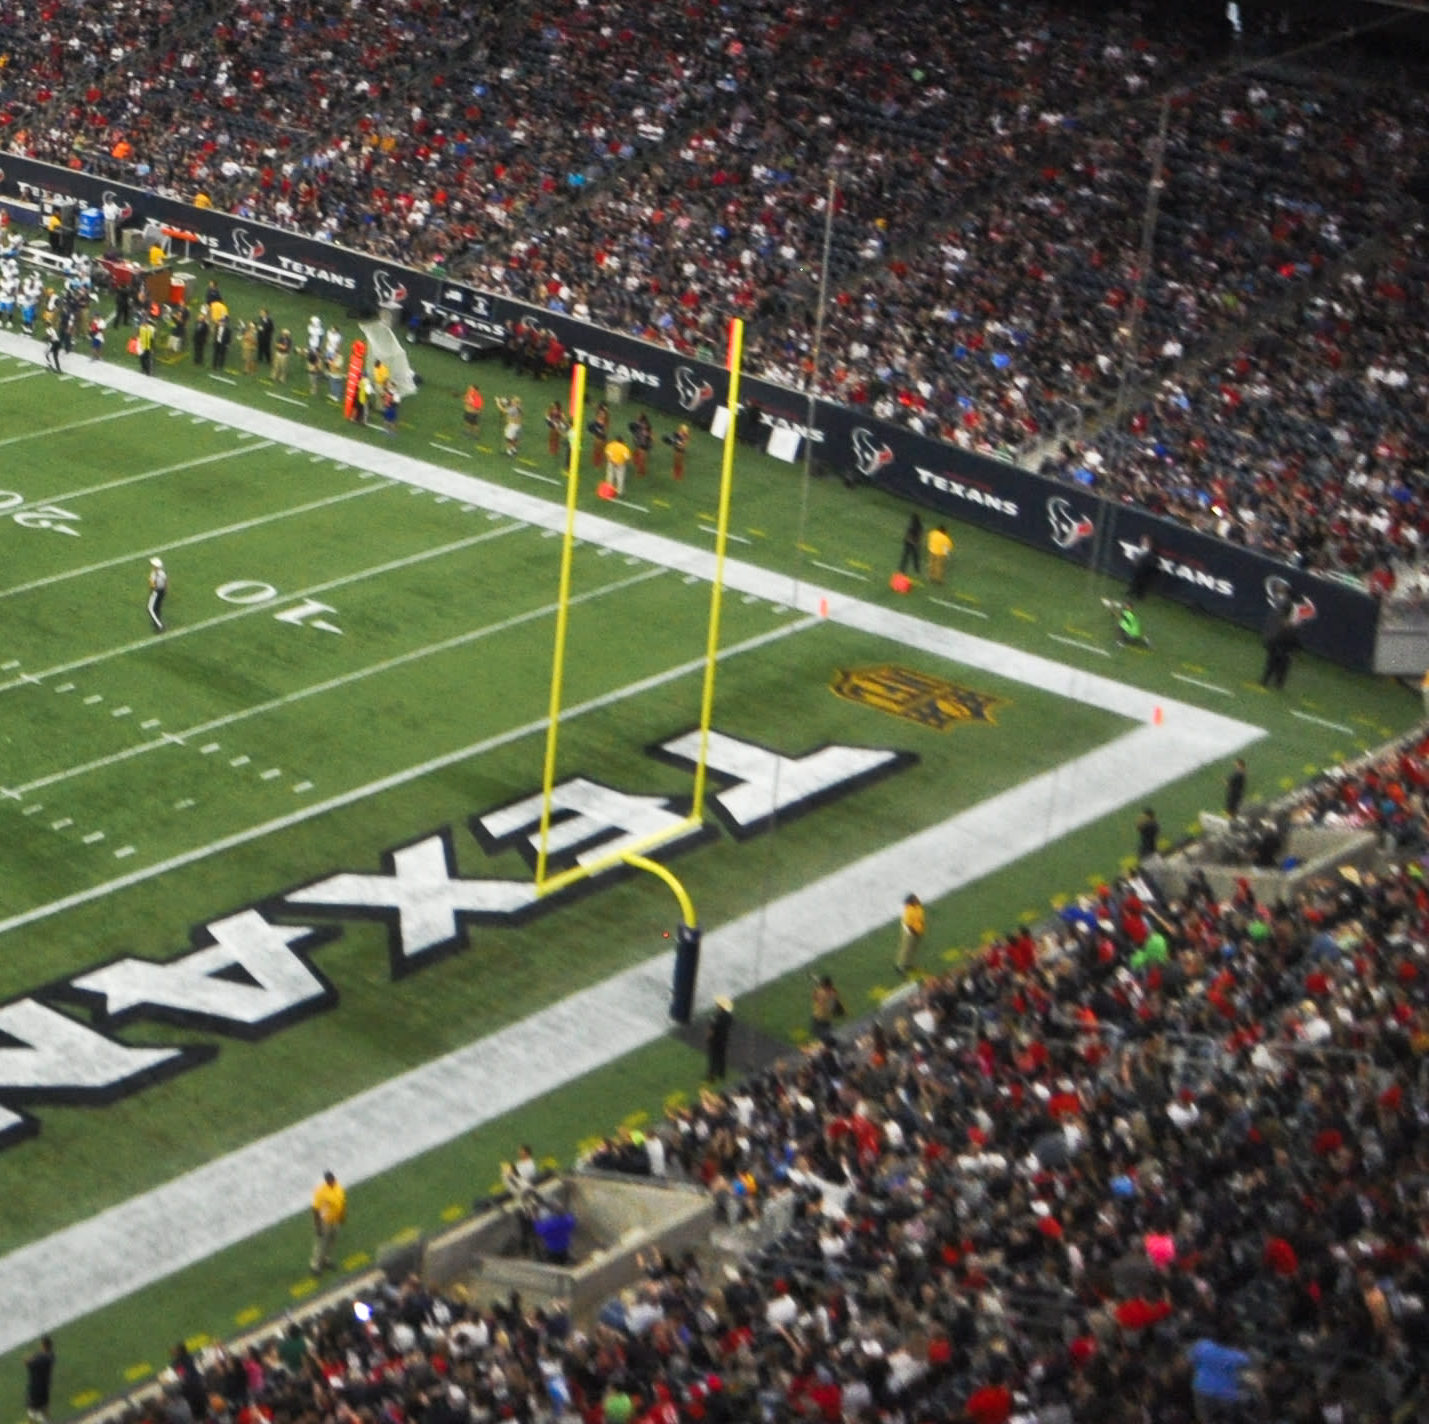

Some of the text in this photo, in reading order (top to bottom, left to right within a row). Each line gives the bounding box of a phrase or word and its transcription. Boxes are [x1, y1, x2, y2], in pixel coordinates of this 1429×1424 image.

[277, 255, 357, 291] TEXANS
[573, 348, 661, 388] TEXANS
[913, 465, 1020, 518] TEXANS
[1117, 539, 1235, 598] TXANS
[214, 579, 339, 626] 10
